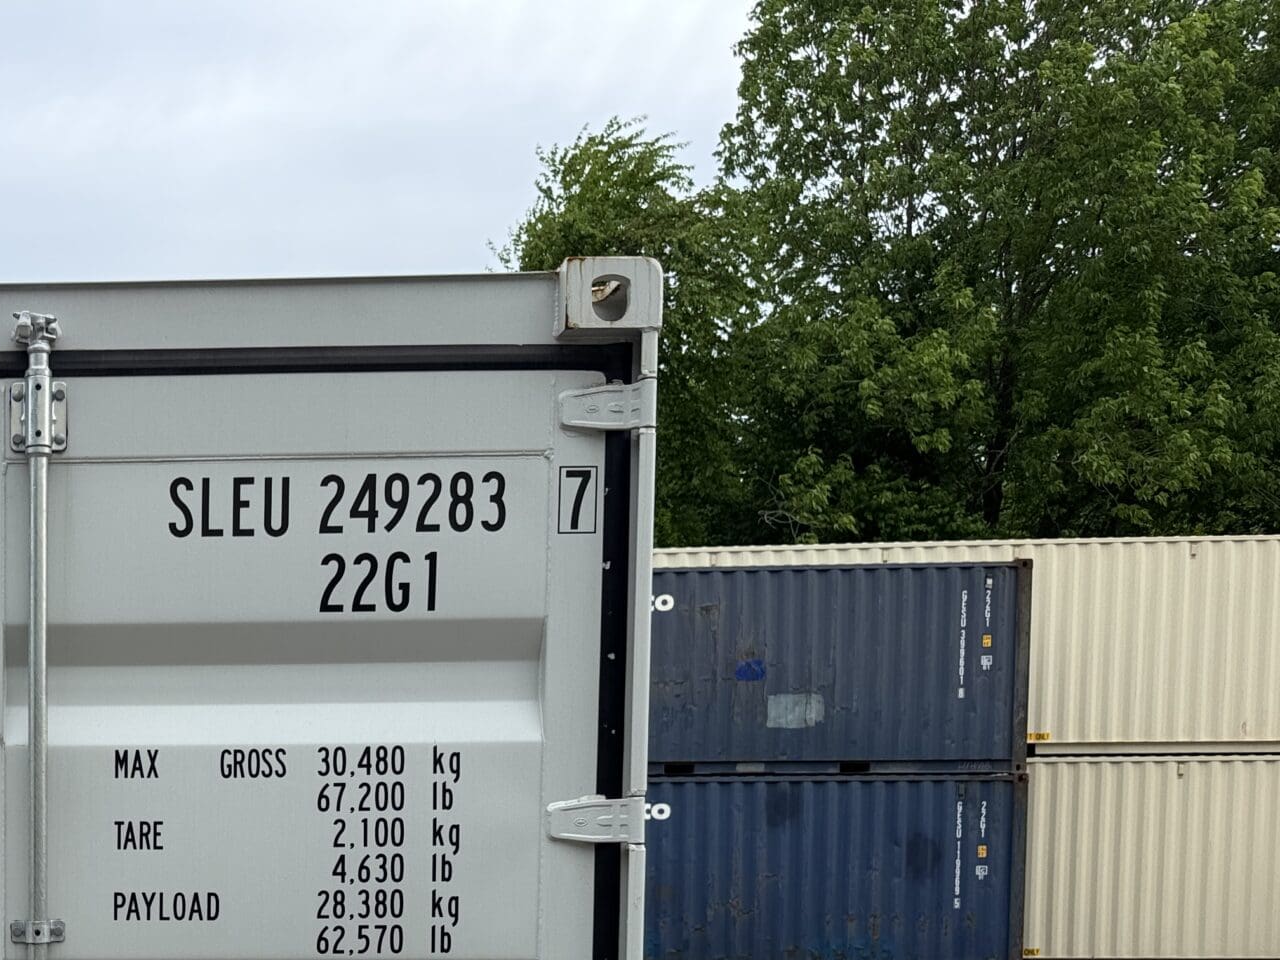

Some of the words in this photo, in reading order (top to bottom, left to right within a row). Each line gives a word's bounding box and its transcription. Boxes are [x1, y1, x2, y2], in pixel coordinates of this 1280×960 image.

[168, 476, 290, 538] SLEU
[319, 471, 507, 535] 249283
[565, 470, 592, 531] 7
[319, 551, 438, 613] 22G1
[114, 749, 159, 779] MAX
[220, 748, 287, 779] GROSS
[317, 745, 405, 778] 30,480
[432, 745, 461, 783] kg
[317, 781, 405, 812] 67,200
[432, 781, 454, 811] lb
[114, 821, 164, 850] TARE
[333, 817, 405, 849] 2,100
[432, 817, 461, 855] kg
[332, 853, 405, 884] 4,630
[431, 853, 453, 883] lb
[114, 892, 220, 921] PAYLOAD
[316, 889, 404, 921] 28,380
[431, 889, 460, 927] kg
[316, 925, 404, 956] 62,570
[430, 925, 452, 954] lb
